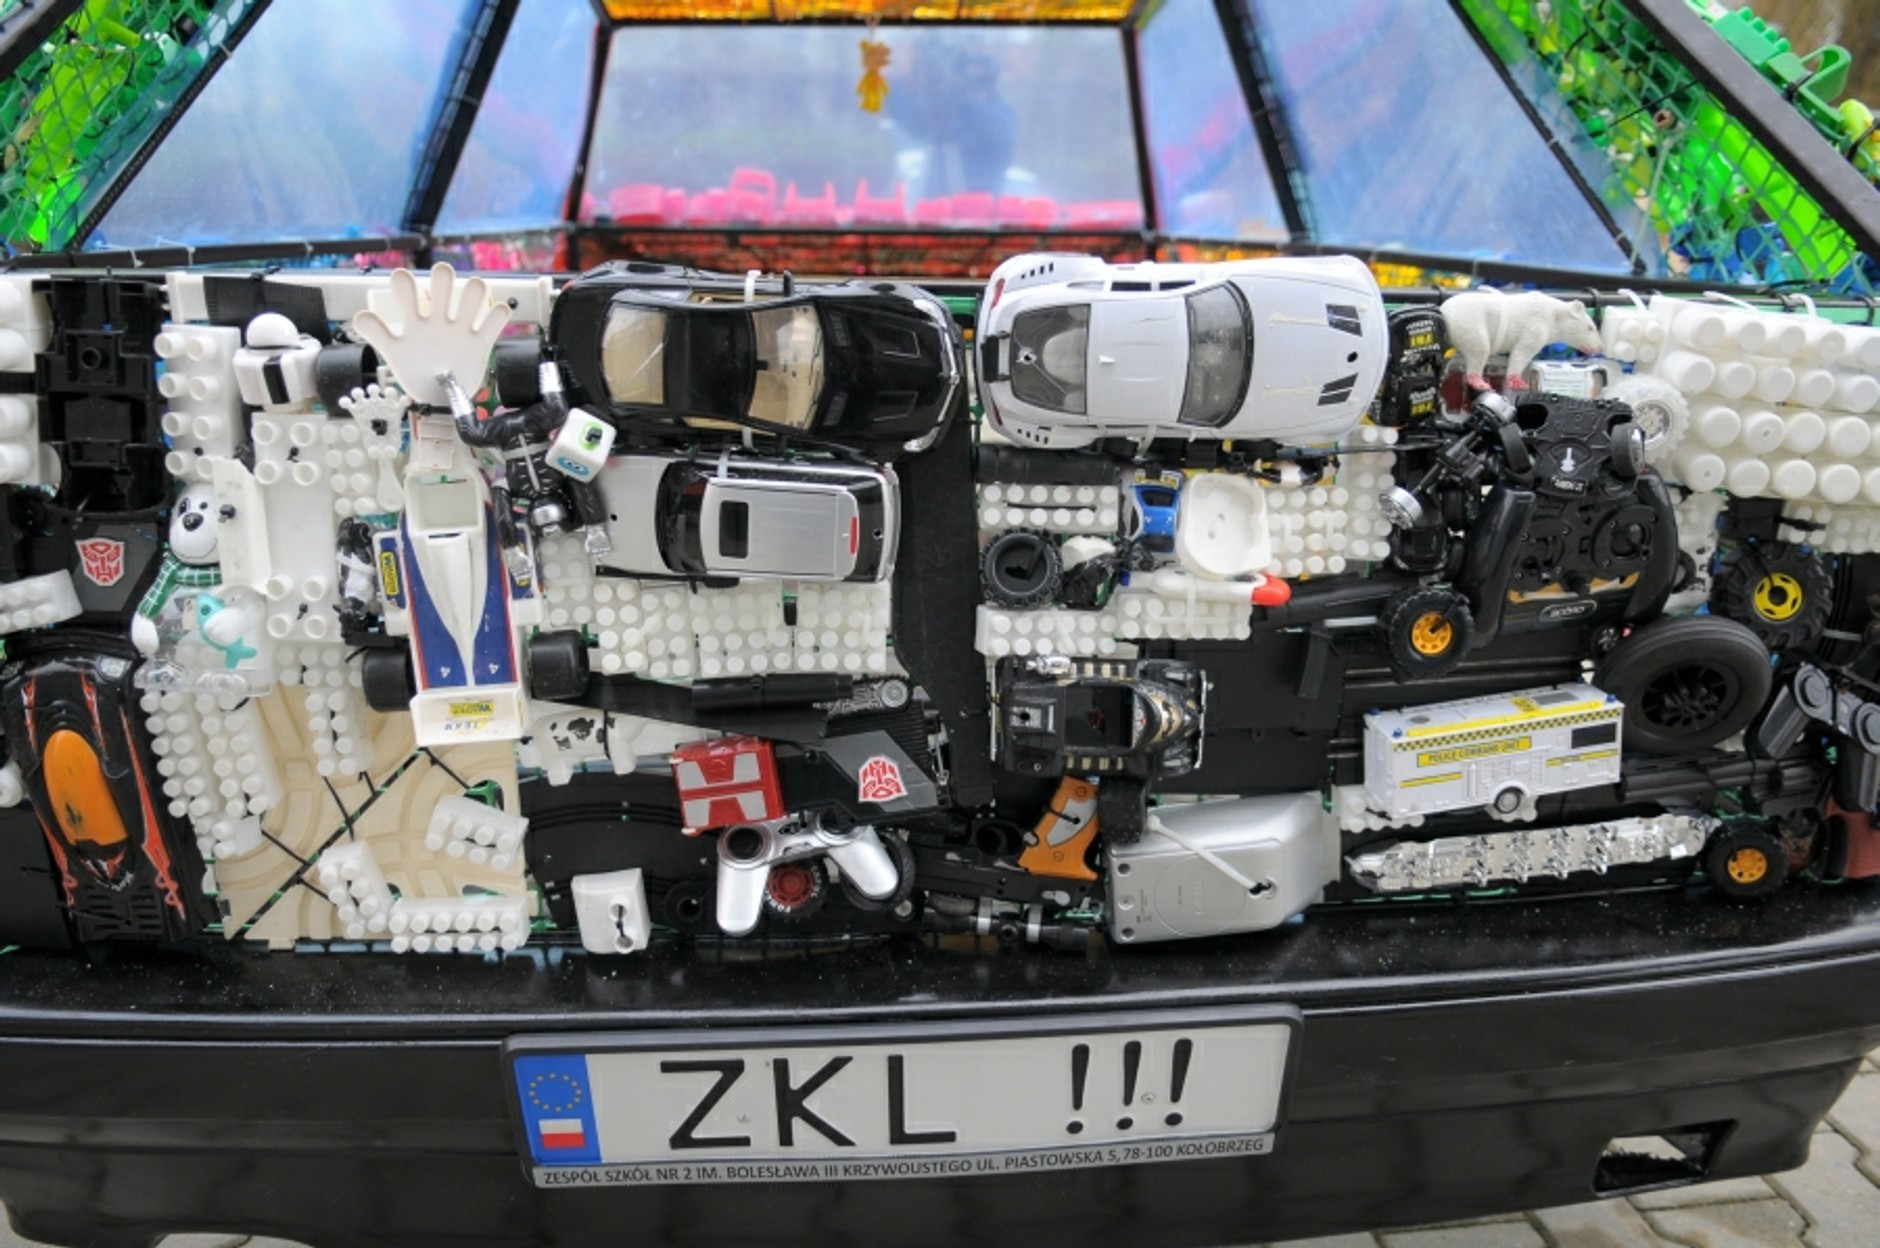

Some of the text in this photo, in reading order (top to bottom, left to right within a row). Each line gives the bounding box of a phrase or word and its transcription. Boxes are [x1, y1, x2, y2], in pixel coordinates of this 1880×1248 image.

[1428, 750, 1457, 764] POLICE
[544, 1167, 601, 1185] ZESPÓŁ
[605, 1165, 651, 1183] SZKÓŁ
[656, 1168, 680, 1181] NR
[684, 1168, 693, 1180] 2
[697, 1167, 722, 1180] IM.
[727, 1164, 820, 1180] BOLESŁAWA
[824, 1164, 840, 1178] III
[844, 1160, 972, 1178] KRZYWOUSTEGO
[976, 1158, 1000, 1173] UL.
[1004, 1151, 1104, 1170] PIASTOWSKA
[1176, 1137, 1264, 1157] KOŁOBRZEG
